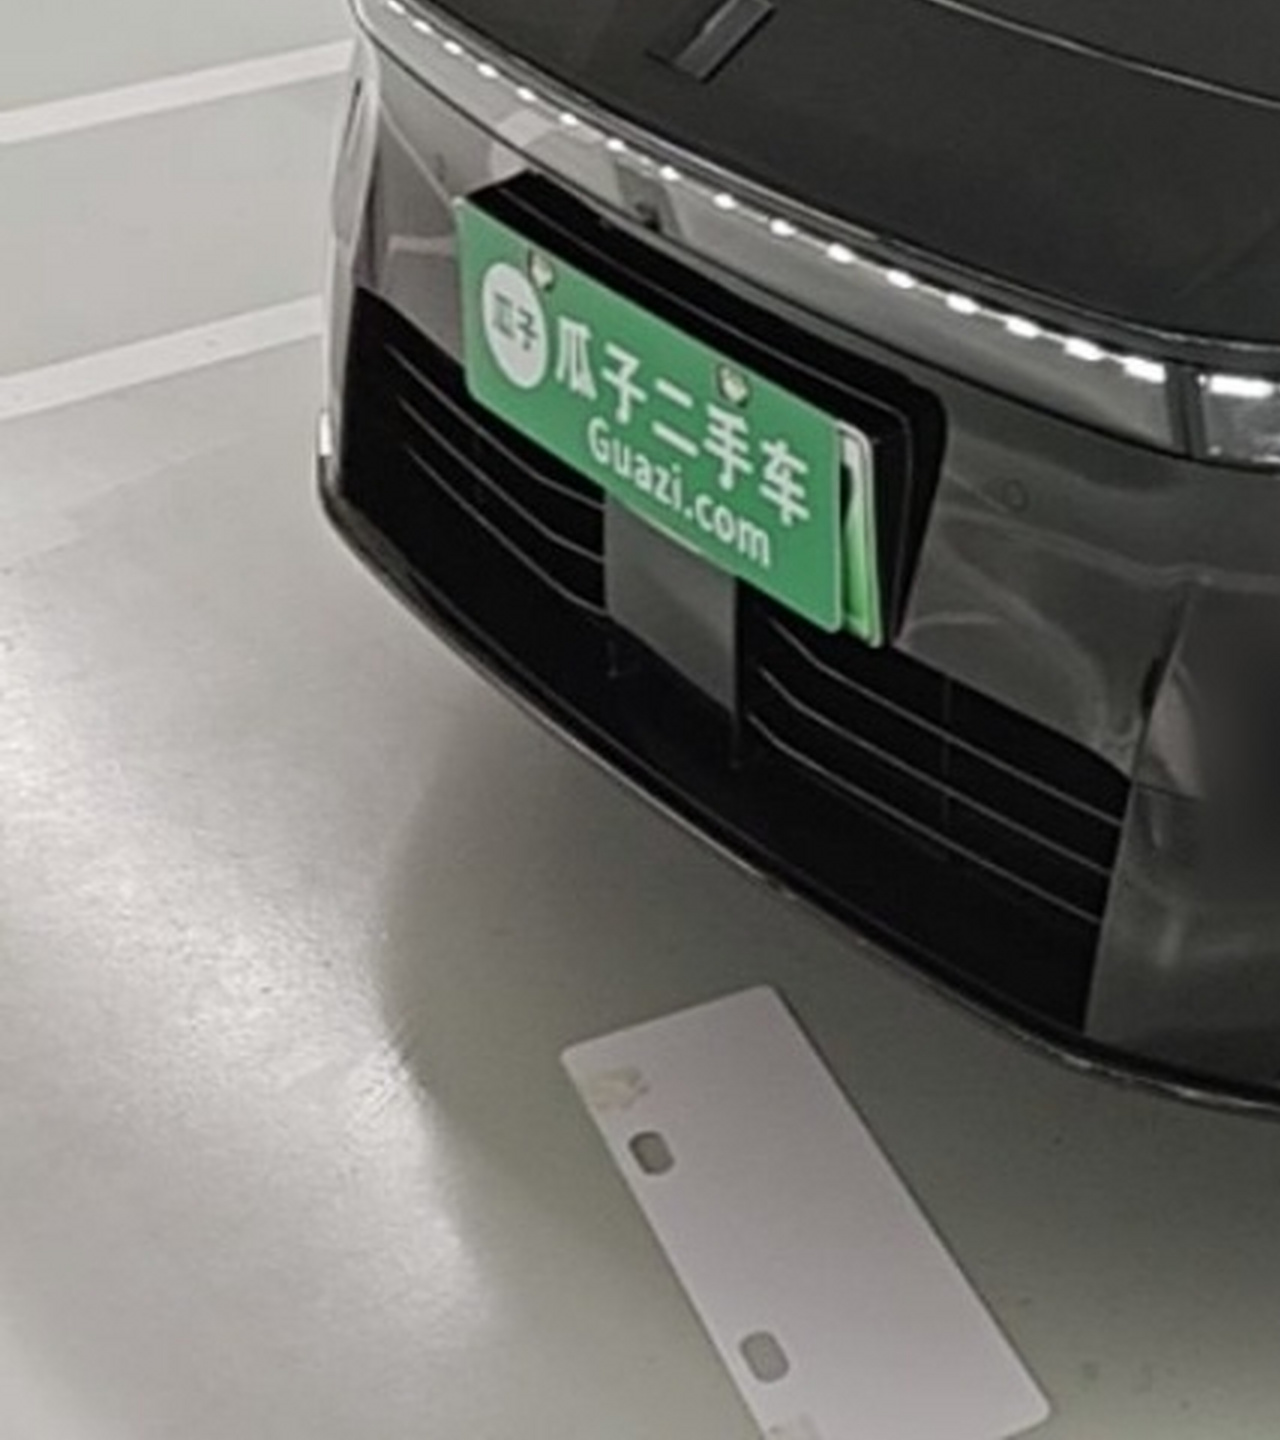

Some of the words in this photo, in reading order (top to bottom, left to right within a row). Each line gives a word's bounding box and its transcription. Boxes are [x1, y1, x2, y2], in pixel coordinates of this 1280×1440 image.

[555, 316, 809, 526] 瓜子二手车
[587, 417, 771, 567] Guazi.com
